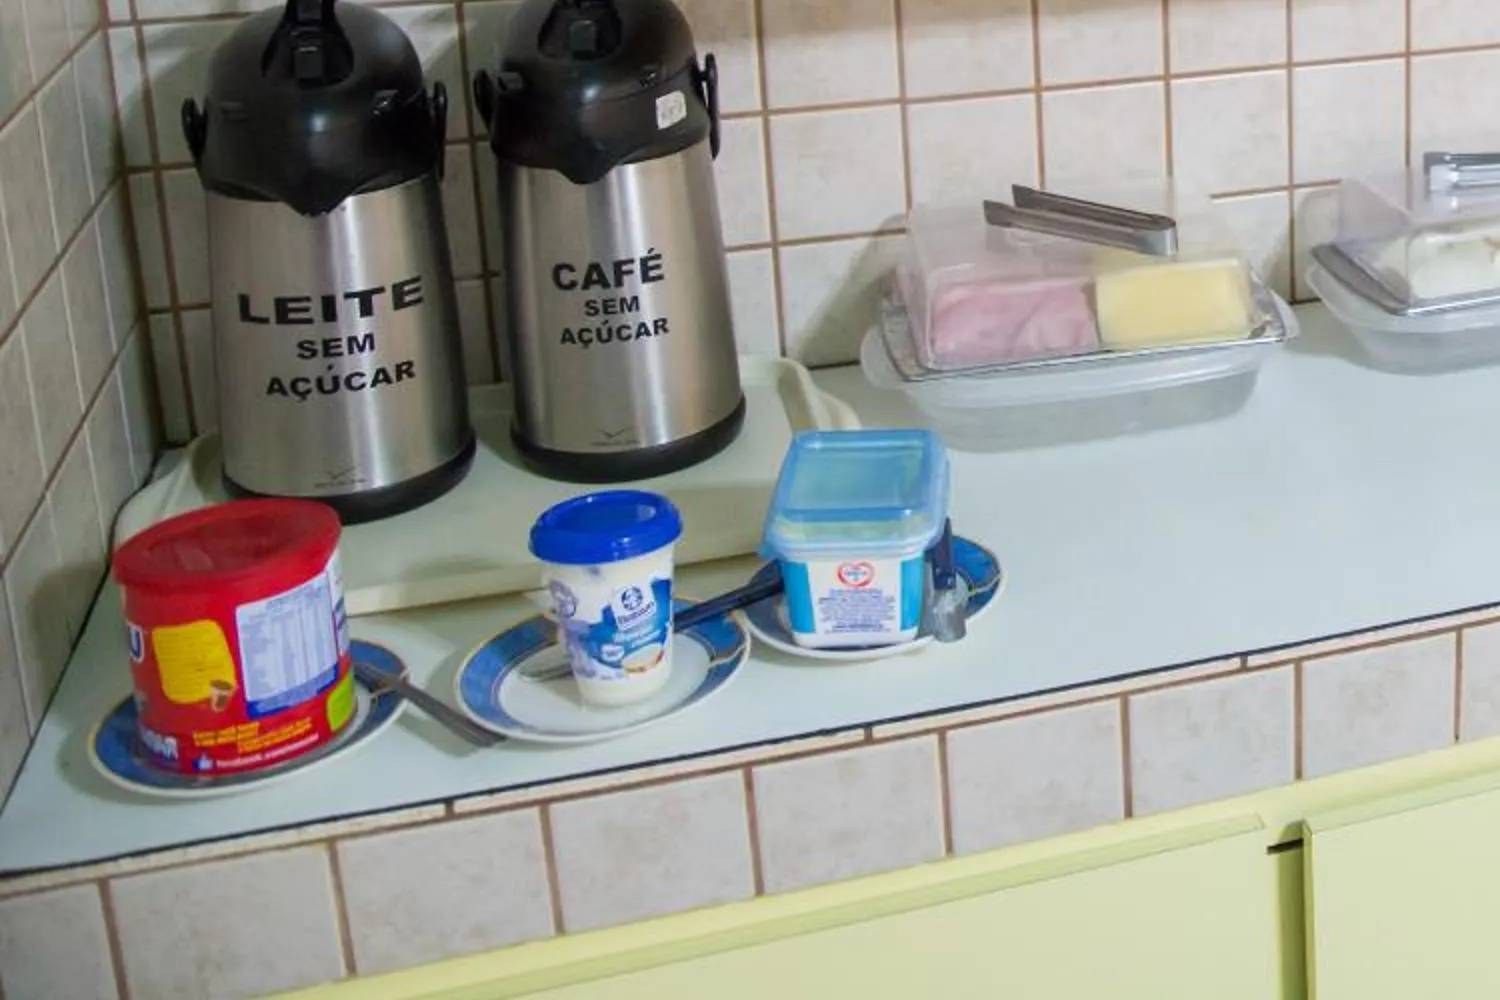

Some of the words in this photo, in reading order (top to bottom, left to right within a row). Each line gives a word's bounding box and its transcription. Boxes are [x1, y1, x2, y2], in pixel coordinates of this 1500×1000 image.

[552, 248, 665, 291] CAFÉ
[238, 276, 424, 324] LEITE
[585, 296, 640, 317] SEM
[297, 333, 376, 360] SEM
[560, 317, 669, 349] AÇÚCAR
[266, 360, 416, 401] AÇÚCAR
